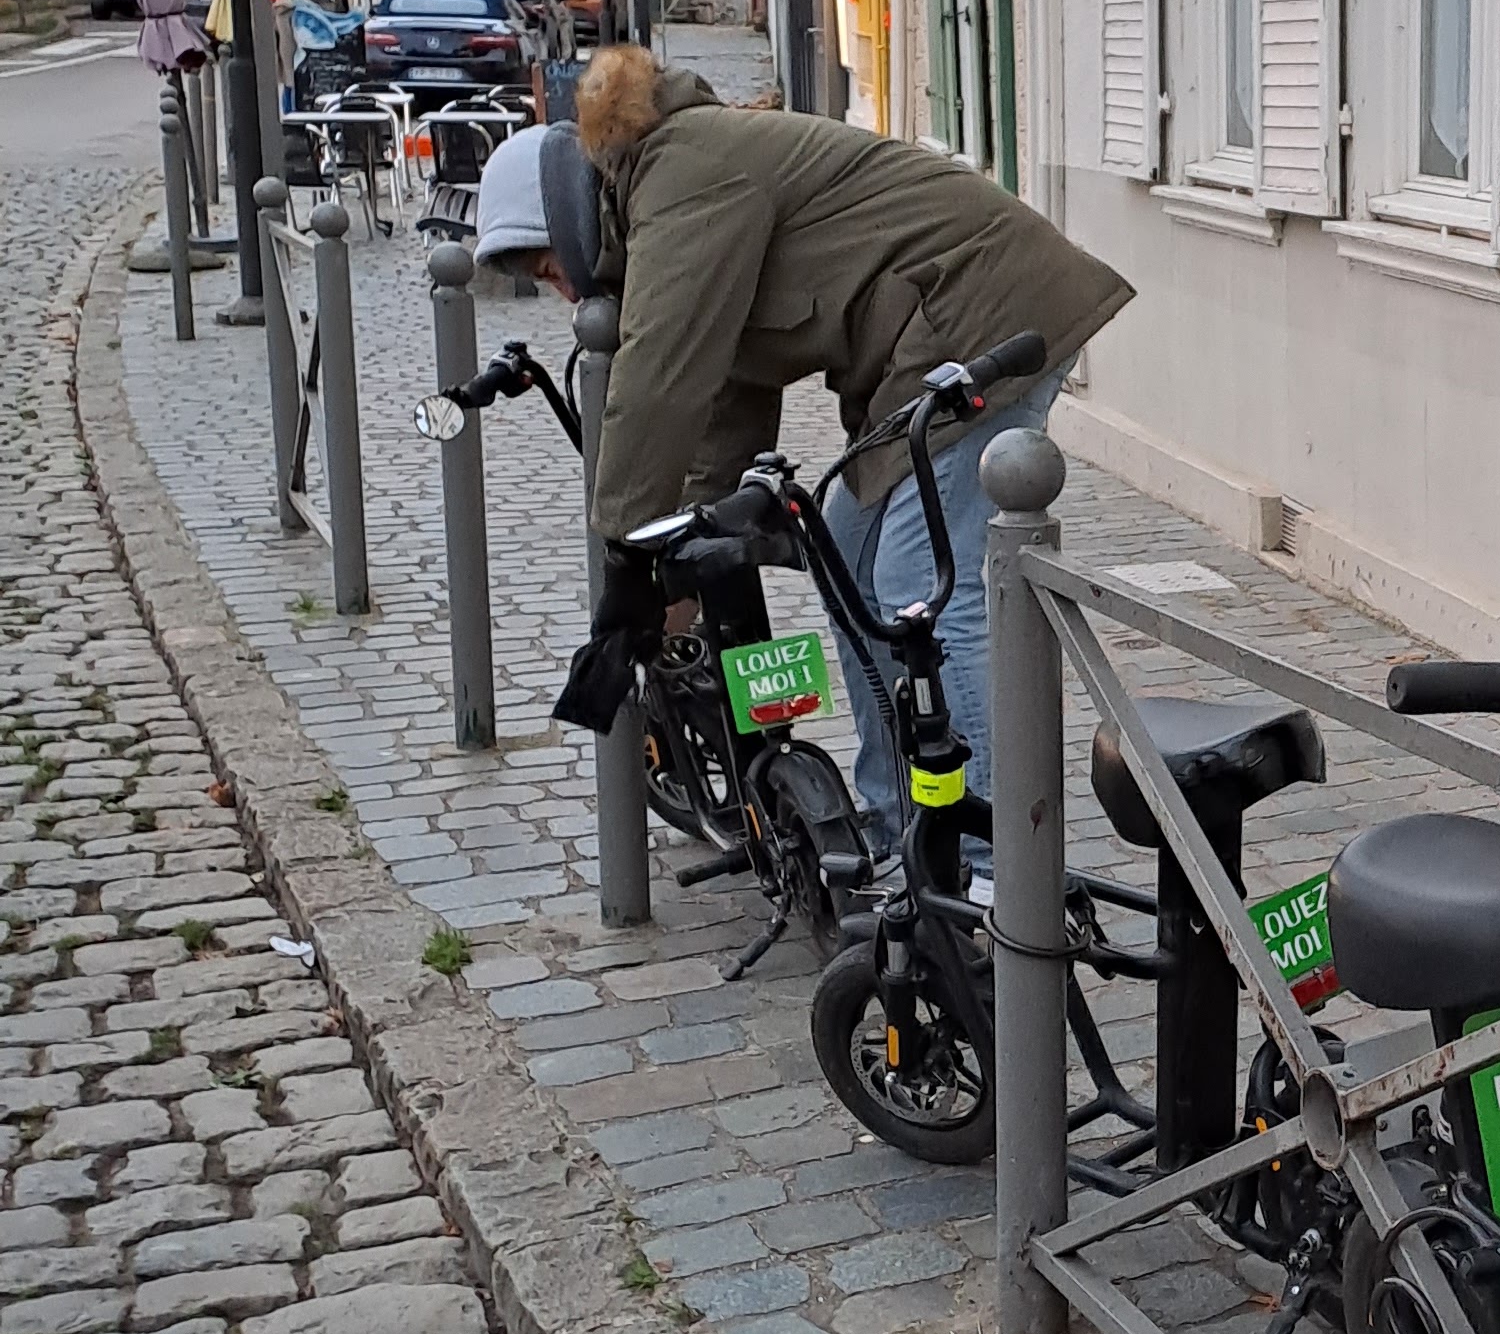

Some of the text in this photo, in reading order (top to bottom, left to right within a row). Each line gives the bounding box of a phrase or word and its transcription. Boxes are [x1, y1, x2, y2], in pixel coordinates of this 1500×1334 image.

[735, 639, 811, 677] LOUEZ
[748, 668, 797, 700] MOI
[1270, 925, 1323, 970] MOI
